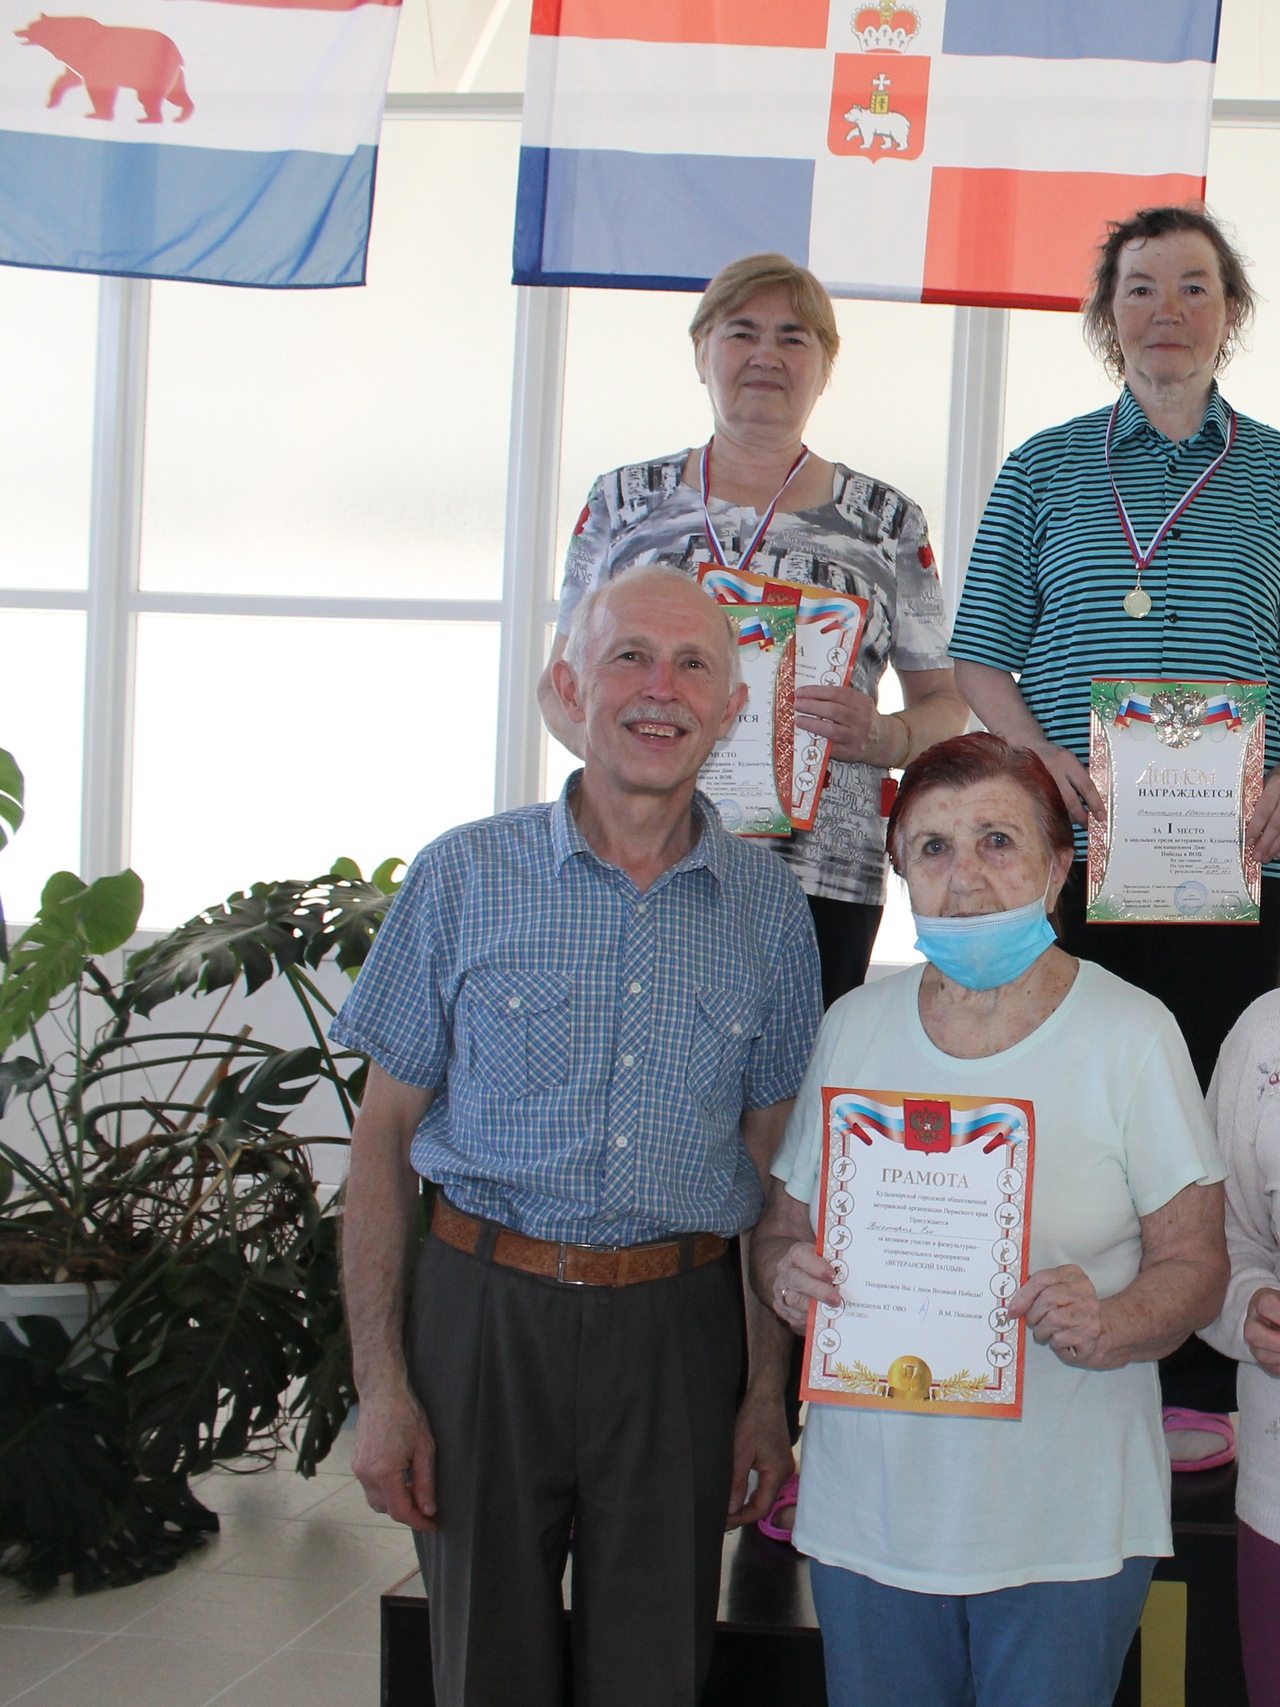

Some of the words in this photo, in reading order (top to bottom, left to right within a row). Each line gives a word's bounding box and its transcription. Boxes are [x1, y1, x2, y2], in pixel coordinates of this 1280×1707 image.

[1138, 788, 1233, 798] НАГРАЖДАЕТСЯ
[1168, 823, 1173, 834] I
[881, 1168, 969, 1188] ГРАМОТА
[943, 1208, 974, 1217] Пермского
